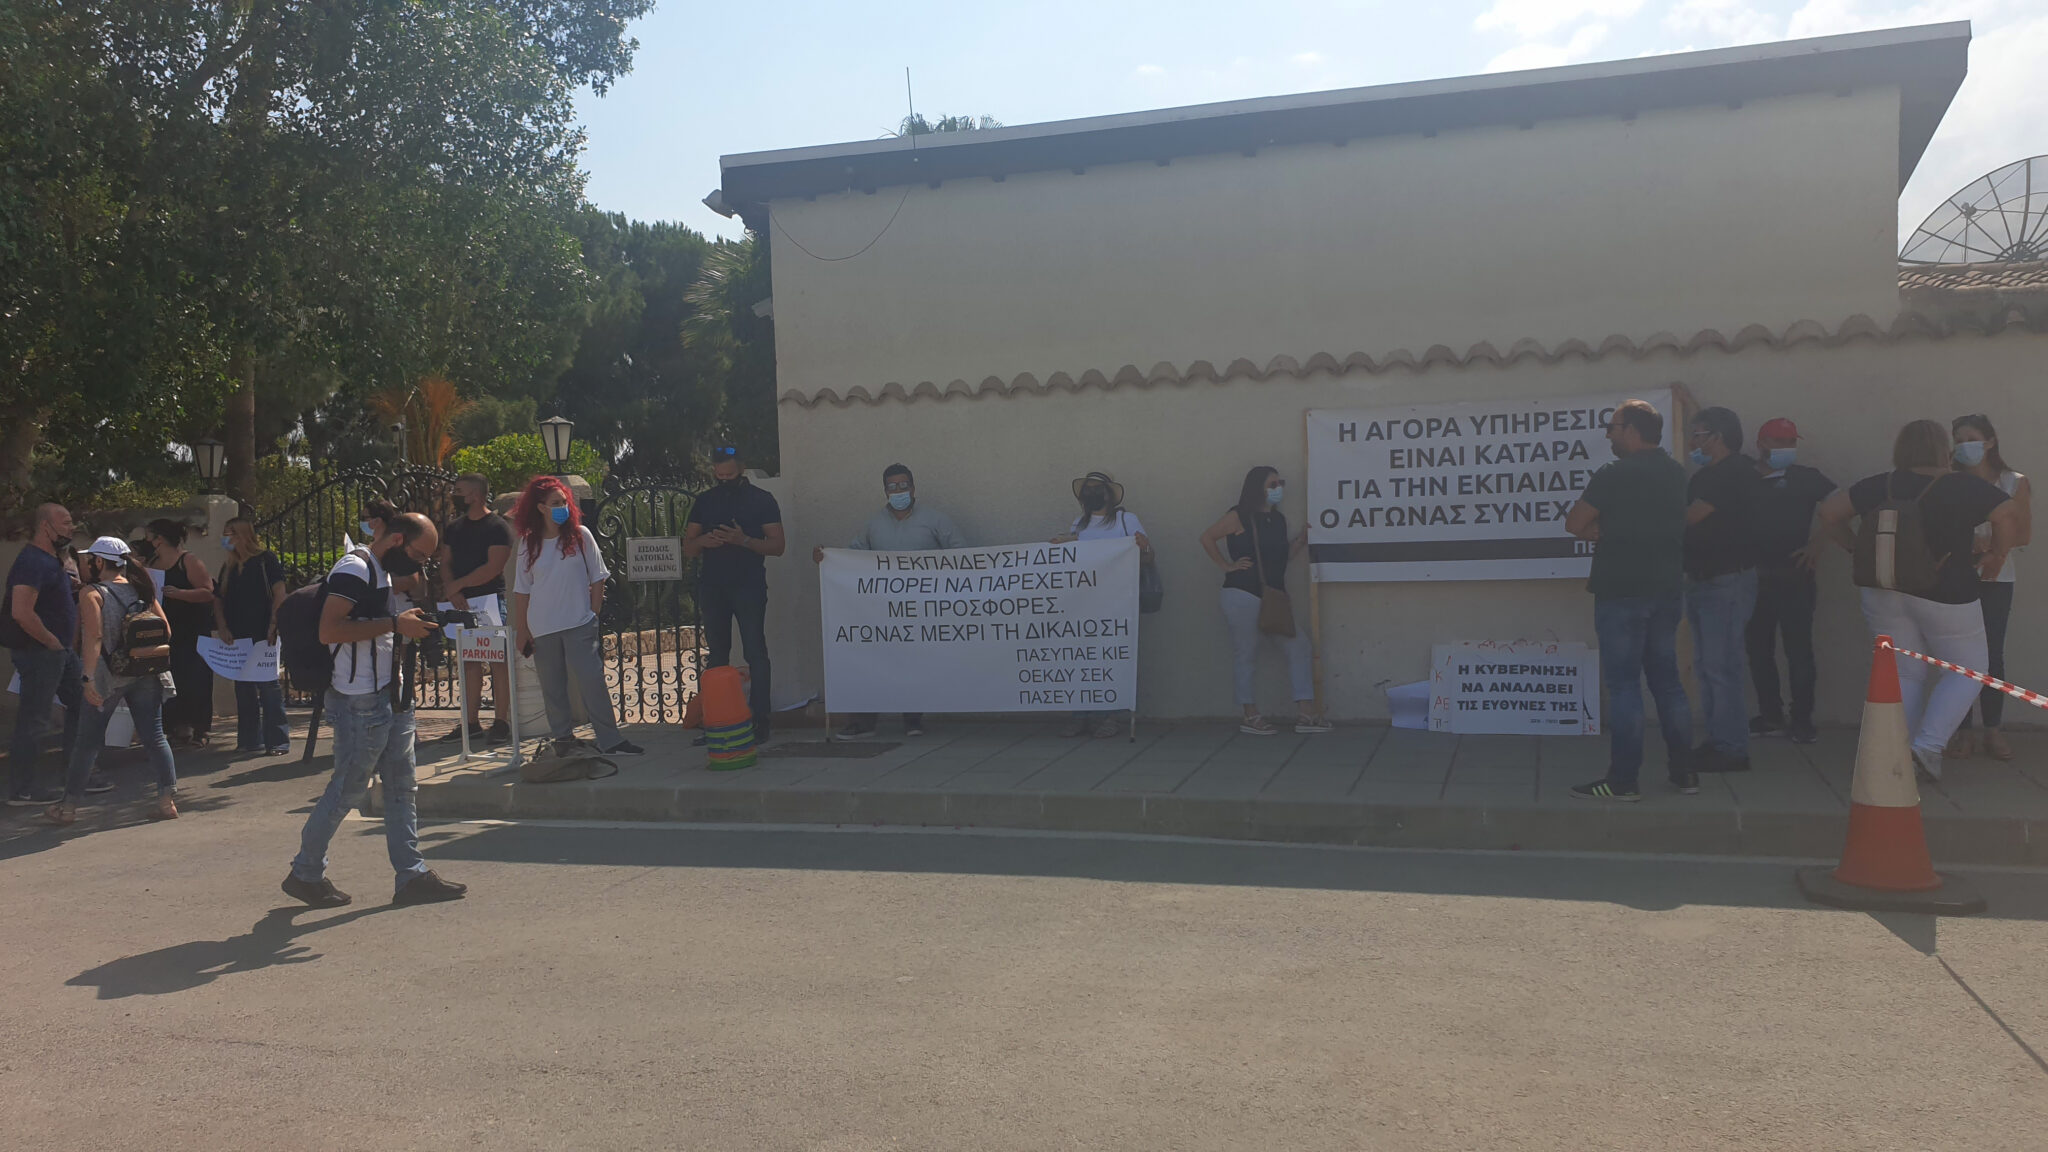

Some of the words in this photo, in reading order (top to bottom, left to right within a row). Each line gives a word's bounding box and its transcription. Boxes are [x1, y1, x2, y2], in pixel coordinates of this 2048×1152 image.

[1338, 422, 1357, 442] Η
[1365, 416, 1462, 442] ΑΓΟΡΑ
[1469, 407, 1614, 438] ΥΠΗΡΕΣΙΩ
[1389, 446, 1465, 470] ΕΙΝΑΙ
[1474, 440, 1590, 465] ΚΑΤΑΡΑ
[1337, 478, 1382, 500] ΓΙΑ
[1389, 476, 1448, 498] ΤΗΝ
[1319, 508, 1340, 529] Ο
[1348, 503, 1467, 528] ΑΓΩΝΑΣ
[1473, 500, 1576, 526] ΣΥΝΕΧ
[1573, 540, 1597, 554] ΠΕ
[634, 553, 674, 561] ΚΑΤΟΙΚΙΑΣ
[877, 556, 890, 571] Η
[898, 550, 1029, 571] ΕΚΠΑΙΔΕΥΣΗ
[1033, 547, 1077, 566] ΔΕΝ
[632, 565, 643, 573] NO
[645, 564, 677, 572] PARKING
[857, 577, 938, 594] ΜΠΟΡΕΙ
[945, 575, 973, 593] ΝΑ
[979, 570, 1097, 591] ΠΑΡΕΧΕΤΑΙ
[888, 600, 917, 618] ΜΕ
[924, 597, 1065, 617] ΠΡΟΣΦΟΡΕΣ.
[835, 625, 914, 642] ΑΓΩΝΑΣ
[921, 623, 985, 641] ΜΕΧΡΙ
[991, 623, 1019, 640] ΤΗ
[1025, 618, 1129, 640] ΔΙΚΑΙΩΣΗ
[476, 637, 490, 647] NO
[462, 649, 504, 659] PARKING
[1016, 647, 1097, 662] ΠΑΣΥΠΑΕ
[1102, 646, 1130, 660] ΚΙΕ
[1018, 669, 1075, 683] ΟΕΚΔΥ
[1081, 668, 1113, 682] ΣΕΚ
[1458, 664, 1469, 675] Η
[1475, 664, 1577, 677] ΚΥΒΕΡΝΗΣΗ
[1462, 682, 1484, 693] ΝΑ
[1489, 682, 1573, 694] ΑΝΑΛΑΒΕΙ
[1019, 690, 1075, 704] ΠΑΣΕΥ
[1080, 689, 1118, 703] ΠΕΟ
[1457, 700, 1478, 711] ΤΙΣ
[1482, 700, 1546, 711] ΕΥΘΥΝΕΣ
[1550, 701, 1577, 712] ΤΗΣ
